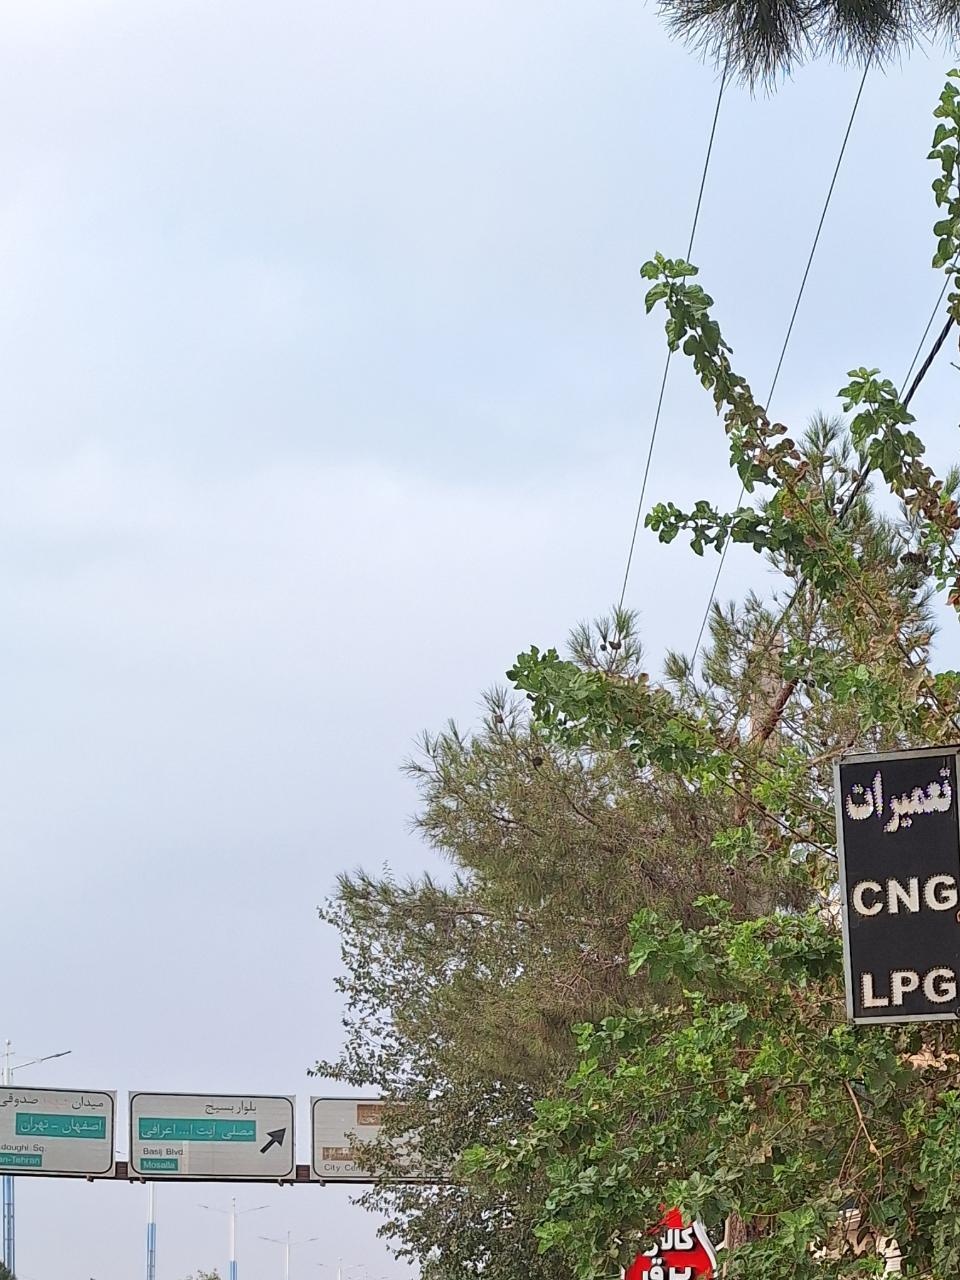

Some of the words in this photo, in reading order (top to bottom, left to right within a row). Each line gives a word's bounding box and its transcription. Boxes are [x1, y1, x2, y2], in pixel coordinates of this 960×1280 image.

[845, 767, 952, 833] تعمیرات
[851, 874, 958, 916] CNG
[860, 966, 958, 1009] LPG
[0, 1093, 39, 1107] صدوقی
[71, 1096, 104, 1110] میدان
[236, 1100, 257, 1115] بلوار
[205, 1104, 234, 1115] بسیج
[20, 1116, 49, 1132] تهران
[62, 1117, 102, 1133] اصفهان
[143, 1147, 163, 1157] Basij
[324, 1163, 340, 1173] City
